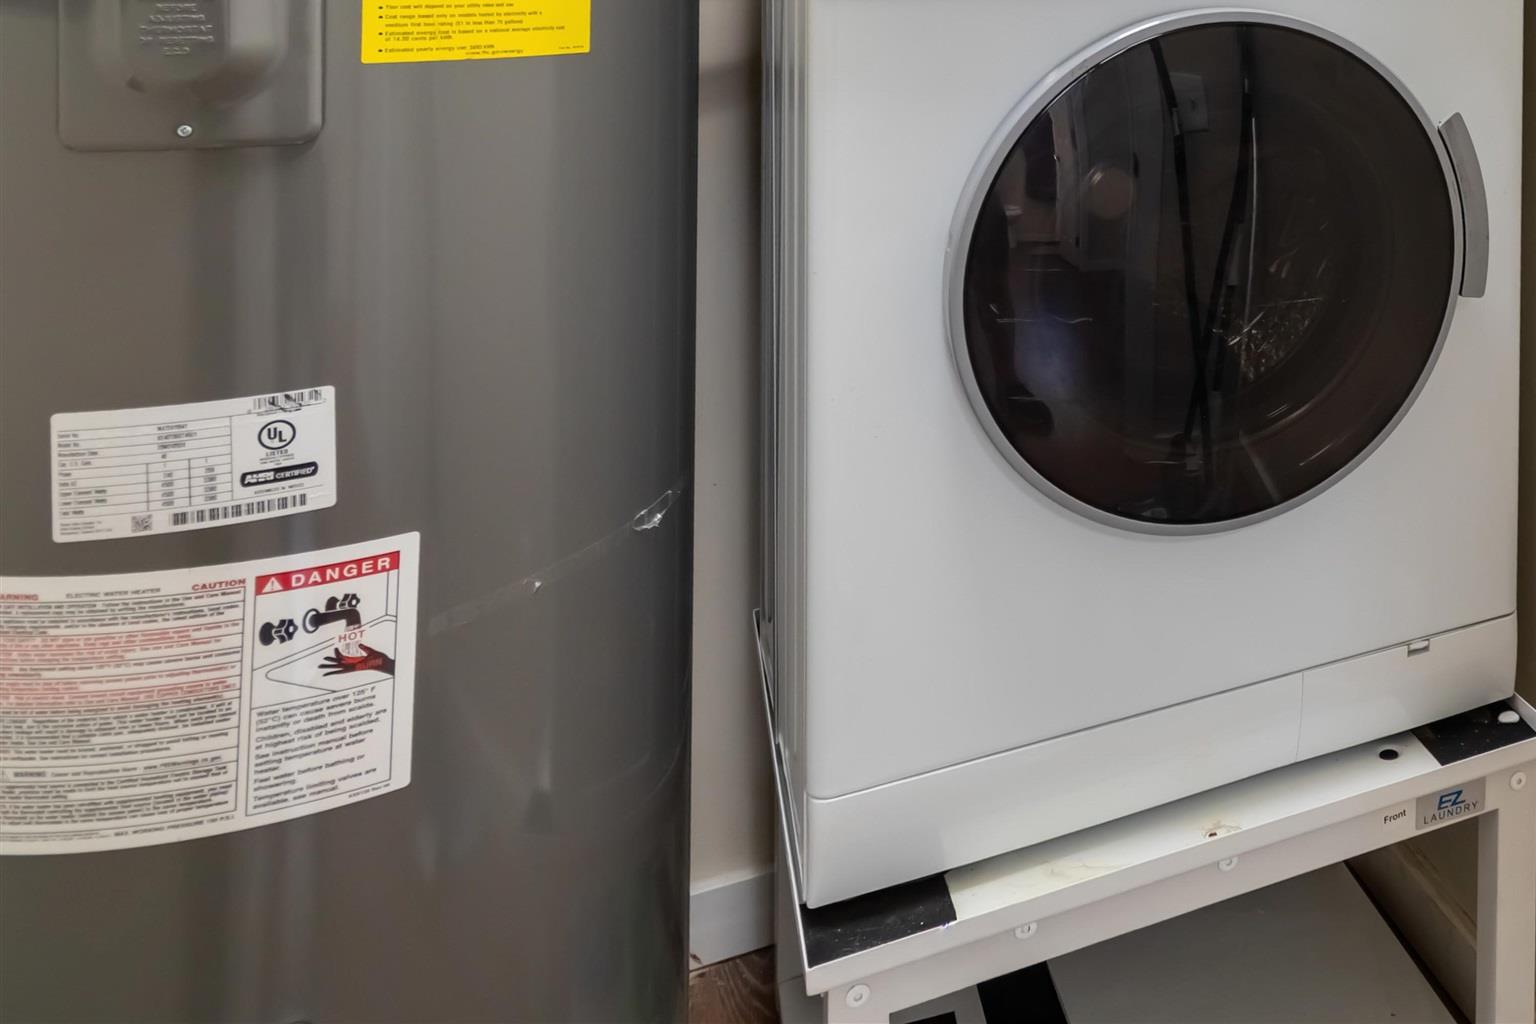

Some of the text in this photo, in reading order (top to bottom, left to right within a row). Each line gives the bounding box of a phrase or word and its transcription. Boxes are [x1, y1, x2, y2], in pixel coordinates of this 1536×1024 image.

[267, 427, 287, 443] UL
[276, 467, 313, 479] CERTIFIED
[291, 557, 391, 587] DANGER
[192, 578, 246, 591] CAUTION
[338, 630, 365, 643] HOT
[282, 698, 330, 712] temperature
[1438, 789, 1466, 811] EZ
[1384, 809, 1407, 824] Front
[1423, 801, 1479, 825] LAUNDRY
